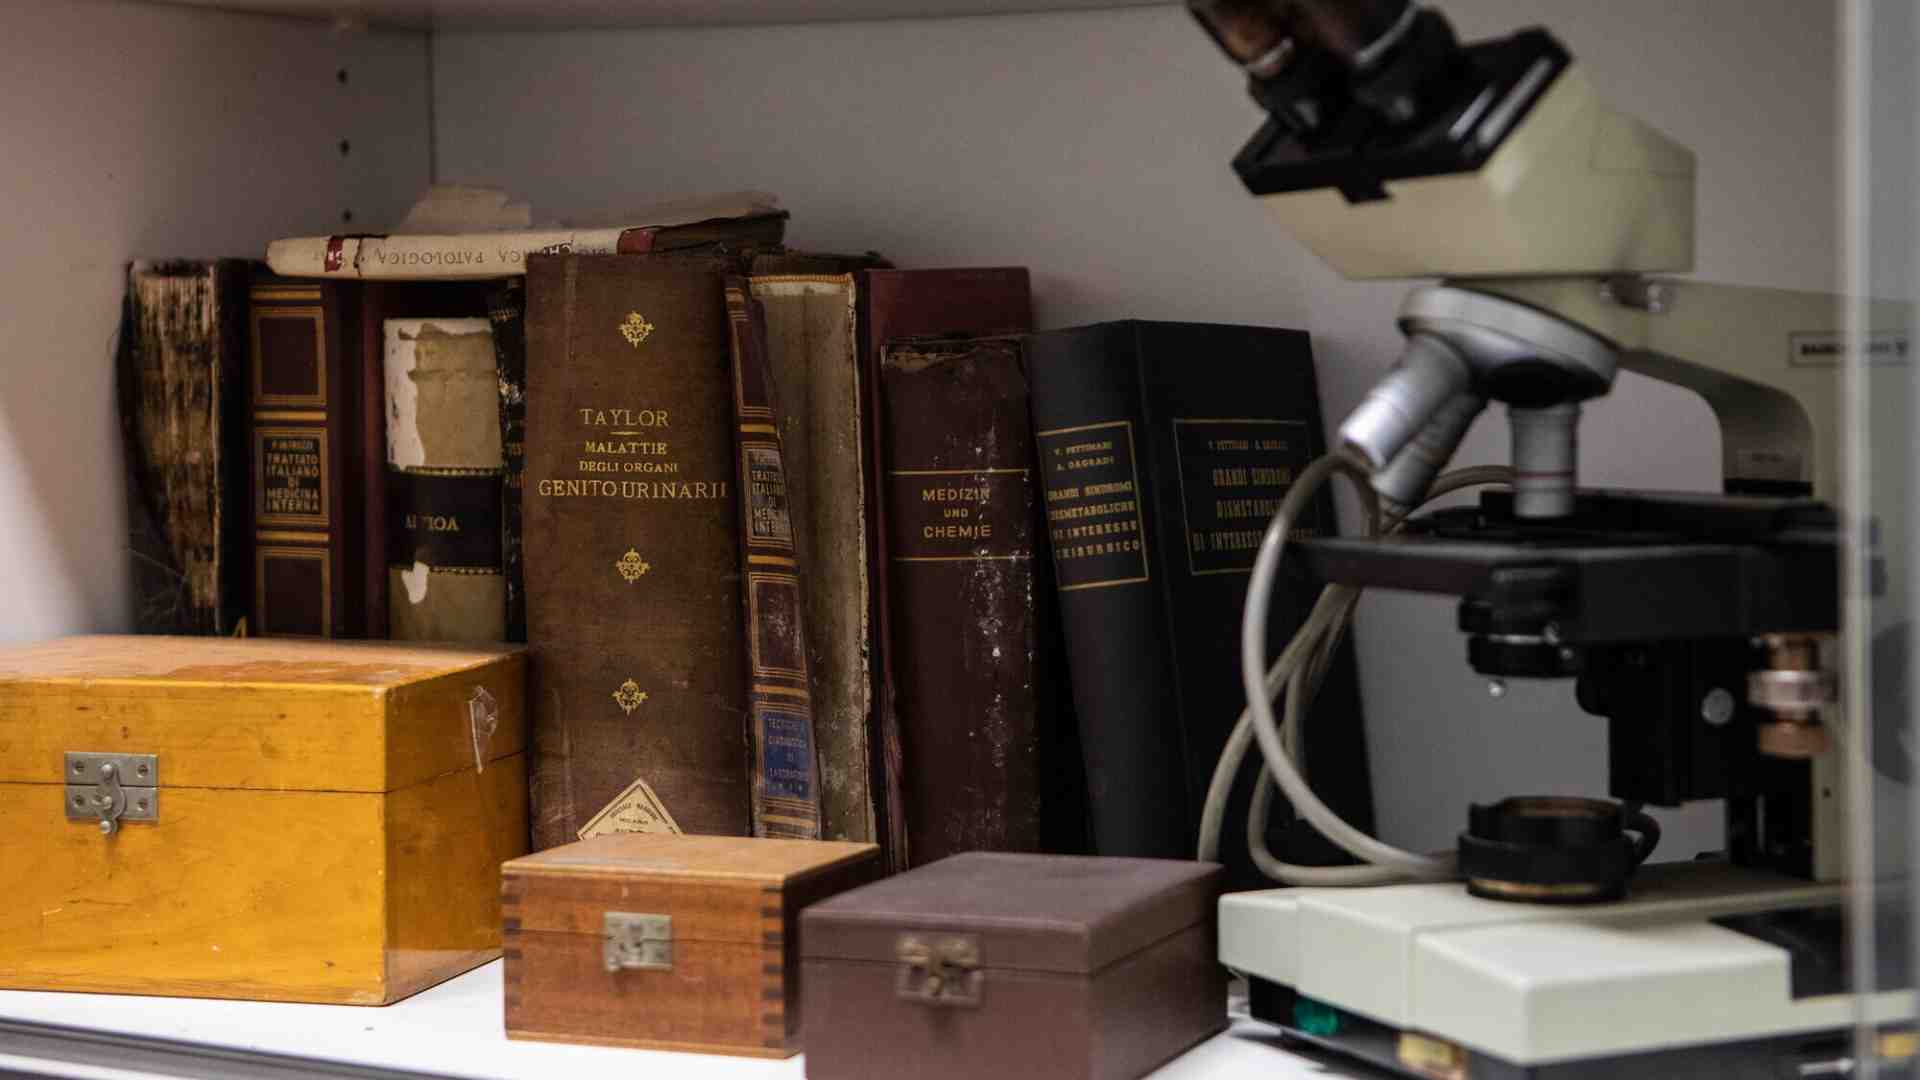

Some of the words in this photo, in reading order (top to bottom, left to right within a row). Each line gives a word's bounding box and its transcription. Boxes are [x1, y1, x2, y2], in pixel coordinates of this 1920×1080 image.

[377, 250, 484, 265] PATOLOGICA
[579, 408, 669, 427] TAYLOR
[585, 440, 667, 455] MALATTIE
[267, 452, 318, 465] TRATTATO
[267, 465, 319, 478] ITALIANO
[579, 460, 619, 472] DEGLI
[624, 462, 679, 473] ORGANI
[922, 488, 991, 501] MEDIZIN
[944, 508, 968, 518] UND
[924, 525, 992, 538] CHEMIE
